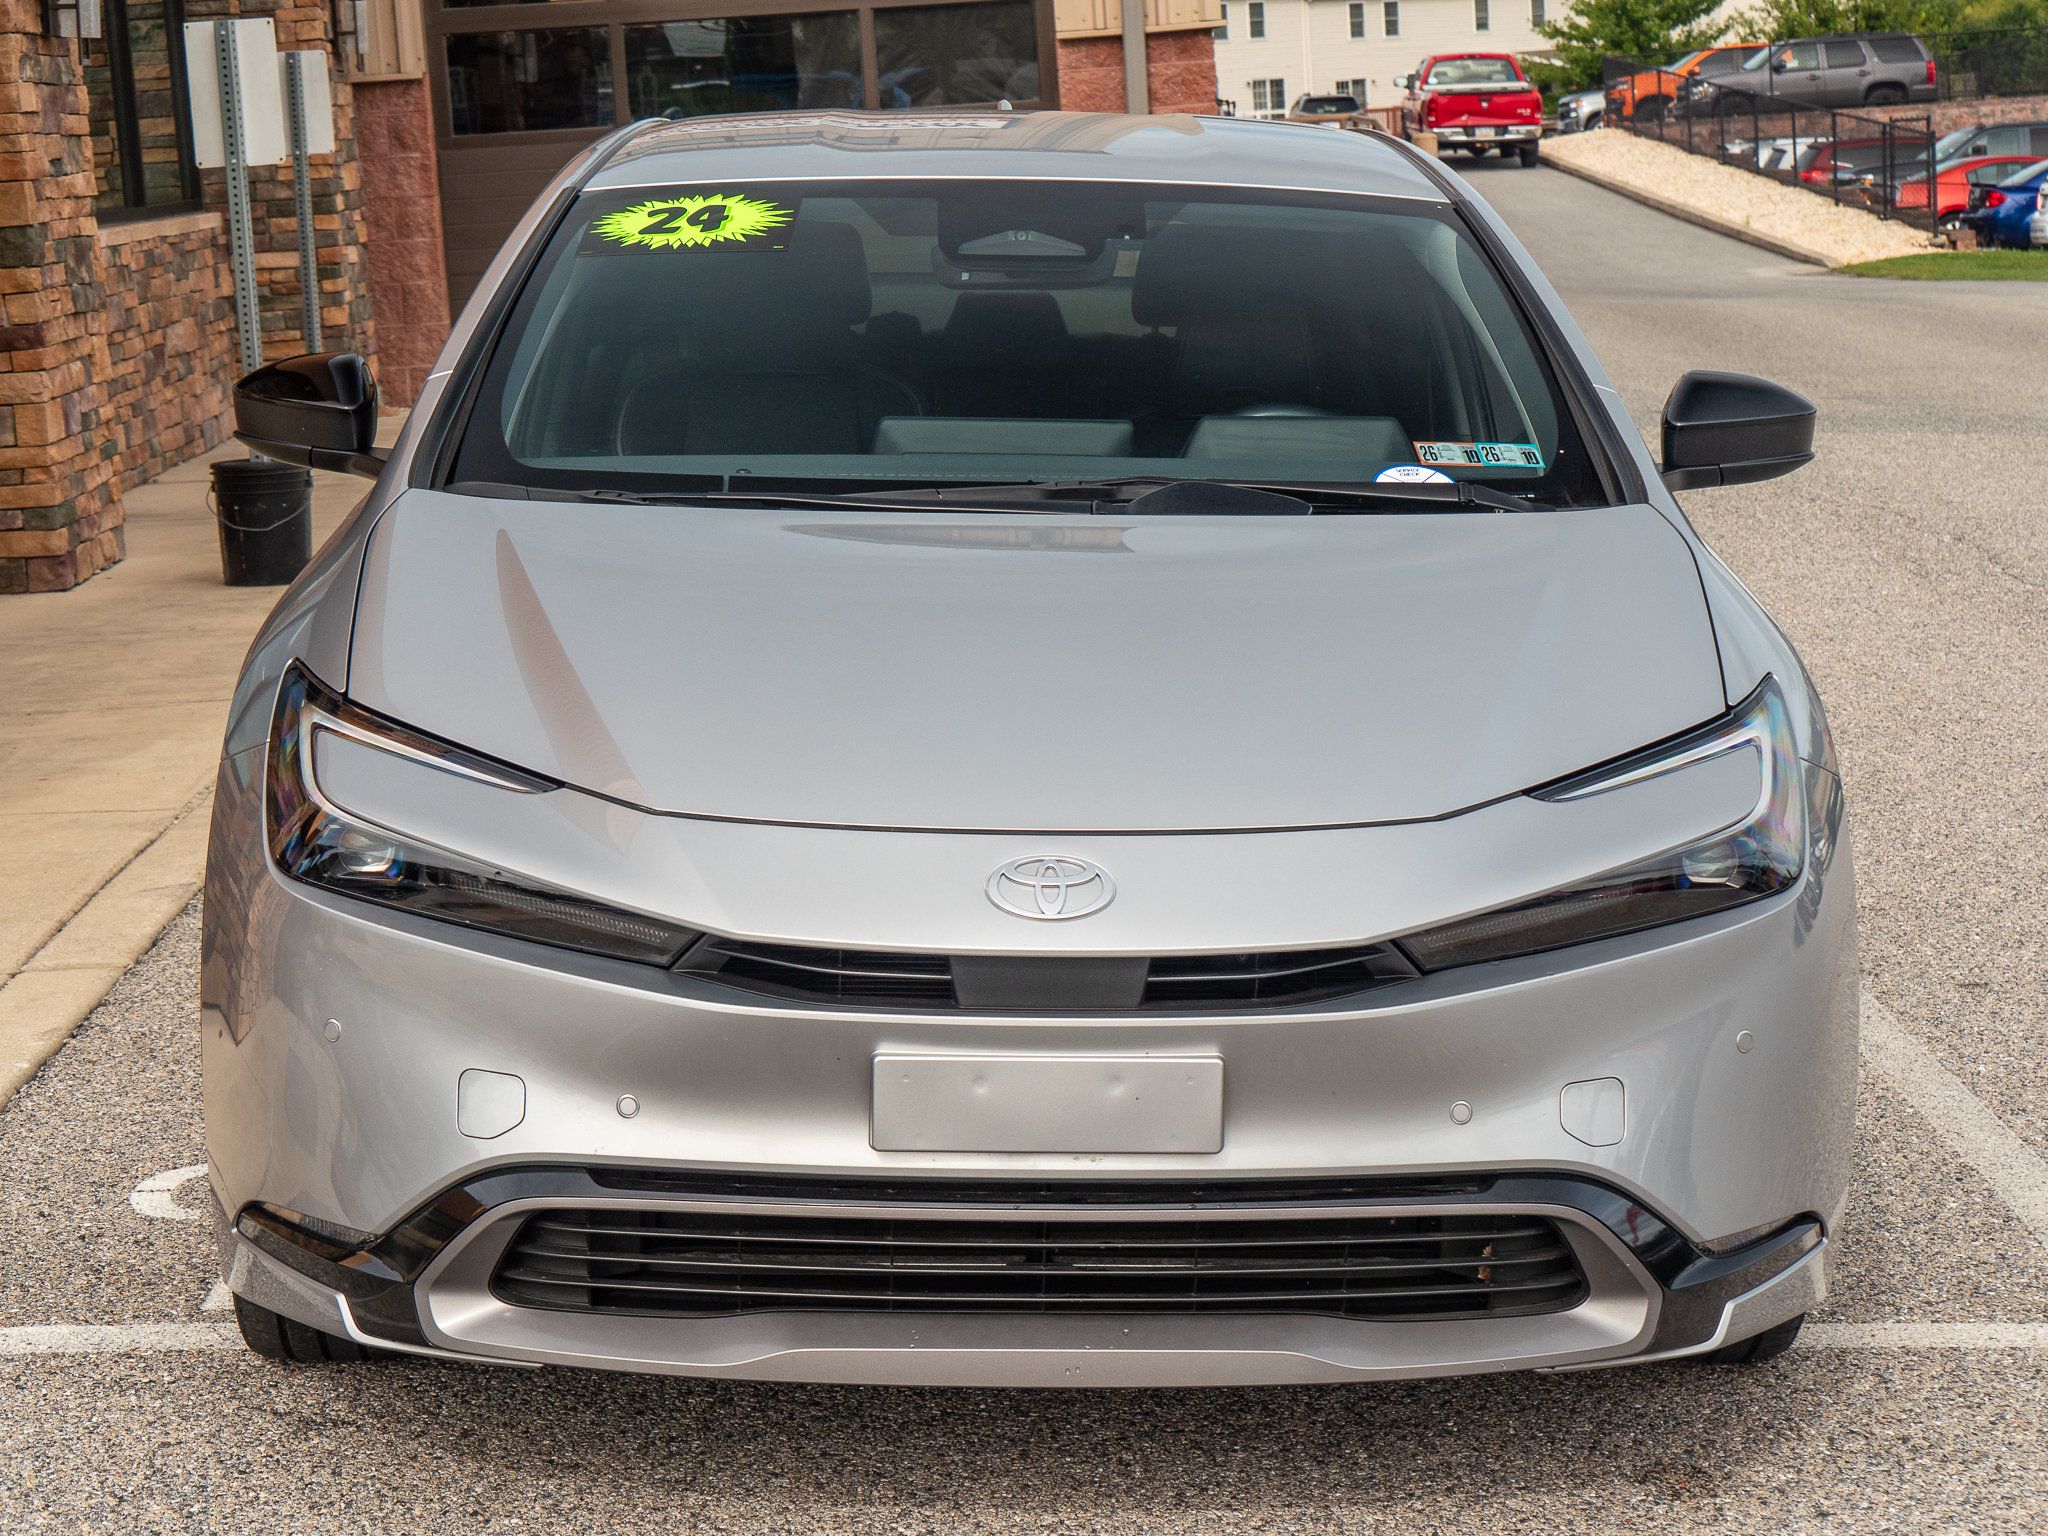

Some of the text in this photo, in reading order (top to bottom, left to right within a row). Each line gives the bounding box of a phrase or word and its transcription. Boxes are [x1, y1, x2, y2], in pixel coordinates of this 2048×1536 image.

[637, 204, 732, 235] 24
[1419, 445, 1438, 461] 26
[1481, 446, 1500, 462] 26
